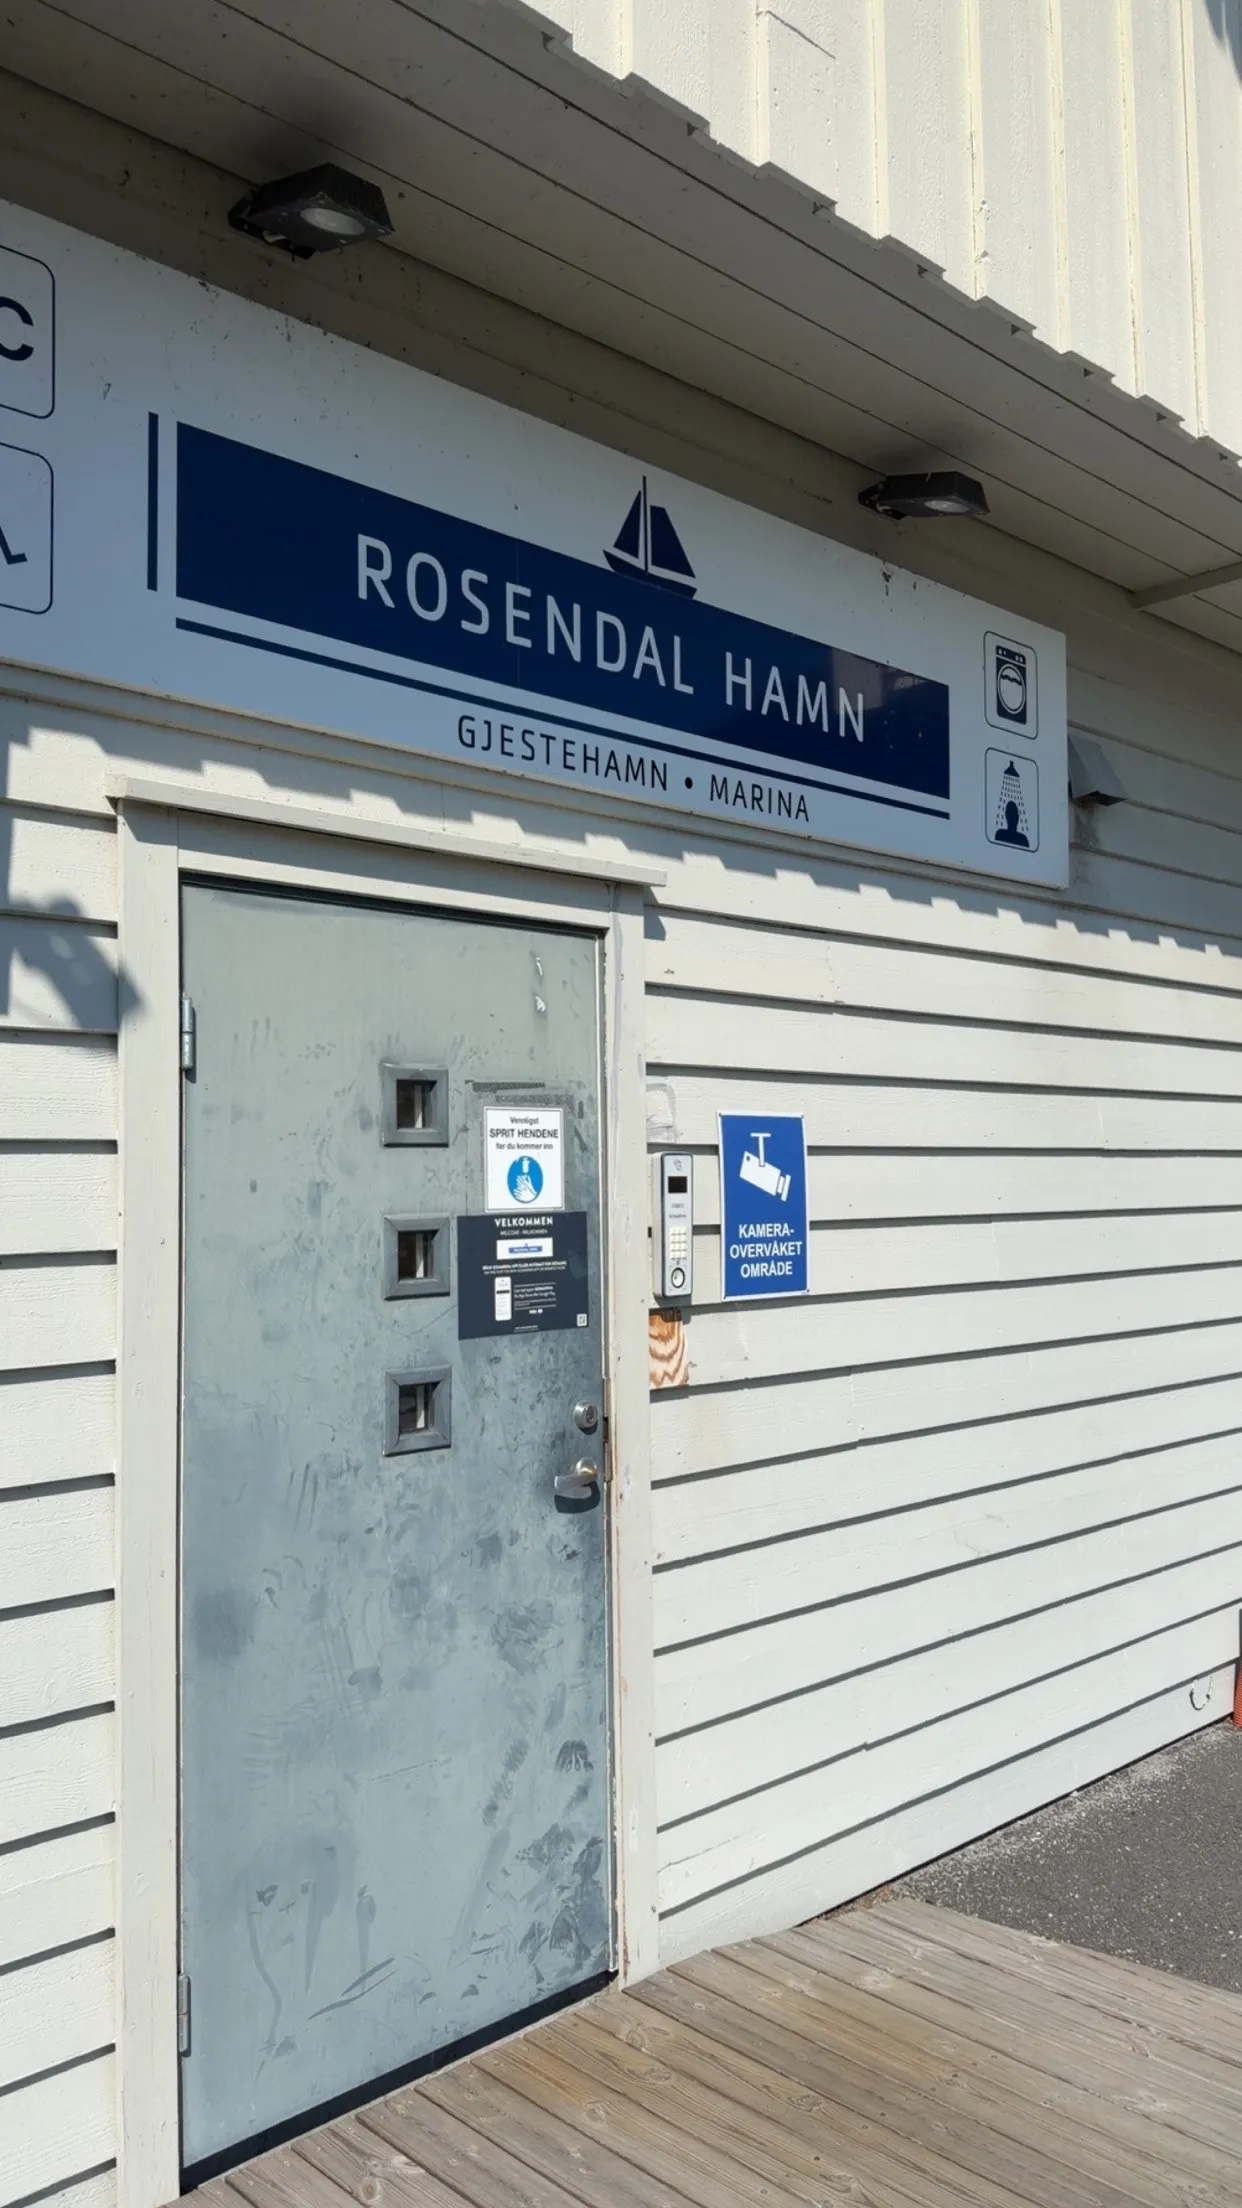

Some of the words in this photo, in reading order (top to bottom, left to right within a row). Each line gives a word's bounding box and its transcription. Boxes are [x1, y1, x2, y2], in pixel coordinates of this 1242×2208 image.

[356, 533, 695, 696] ROSENDAL
[724, 650, 865, 744] HAMN
[457, 714, 668, 792] GJESTEHAMN
[709, 773, 810, 823] MARINA
[509, 1116, 540, 1126] Vennligst
[489, 1128, 515, 1139] SPRIT
[517, 1128, 559, 1139] HENDENE
[507, 1141, 516, 1150] du
[517, 1141, 543, 1150] kommer
[543, 1142, 553, 1150] inn
[494, 1217, 554, 1227] VELKOMMEN
[738, 1223, 795, 1239] KAMERA-
[729, 1240, 803, 1259] OVERVÅKET
[740, 1260, 793, 1279] OMRÅDE
